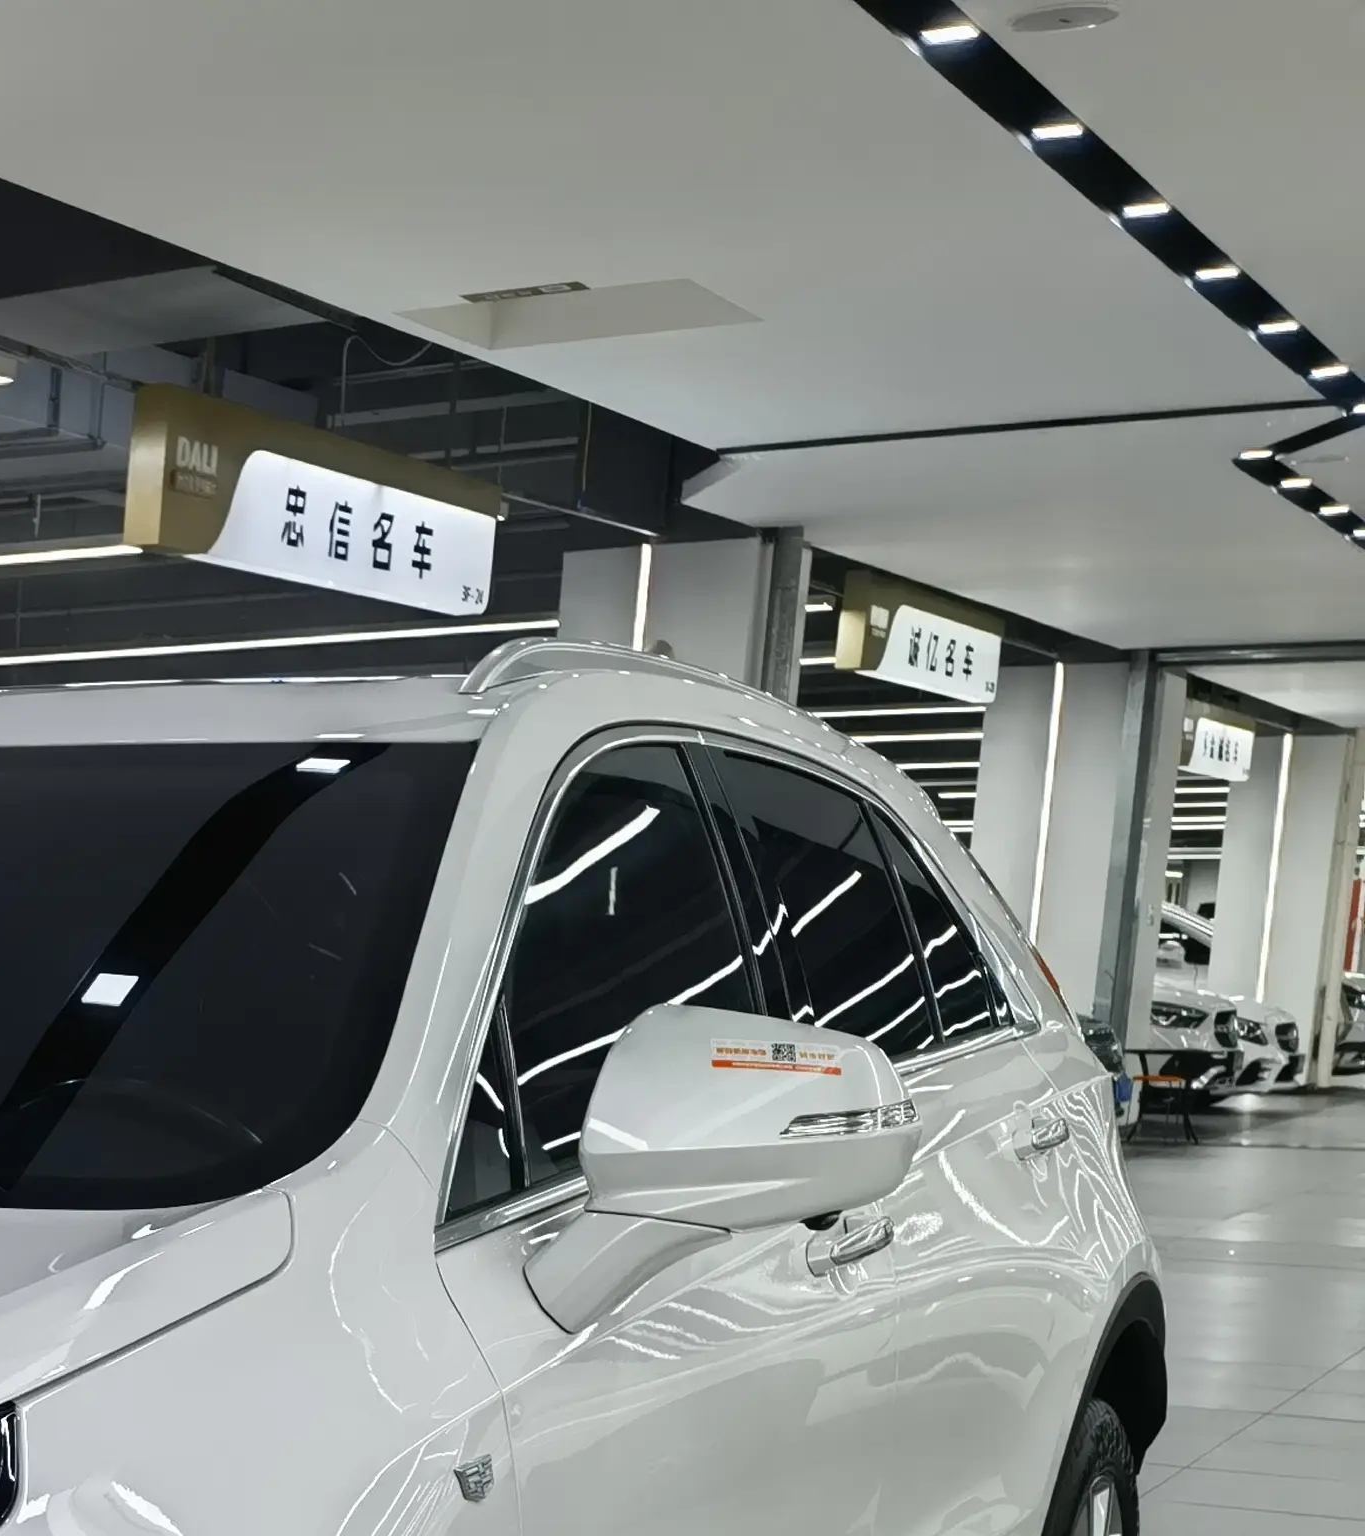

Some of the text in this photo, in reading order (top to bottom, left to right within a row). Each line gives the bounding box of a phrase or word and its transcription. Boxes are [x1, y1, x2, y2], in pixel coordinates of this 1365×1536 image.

[175, 436, 219, 477] DALI
[281, 485, 434, 579] 忠信名车
